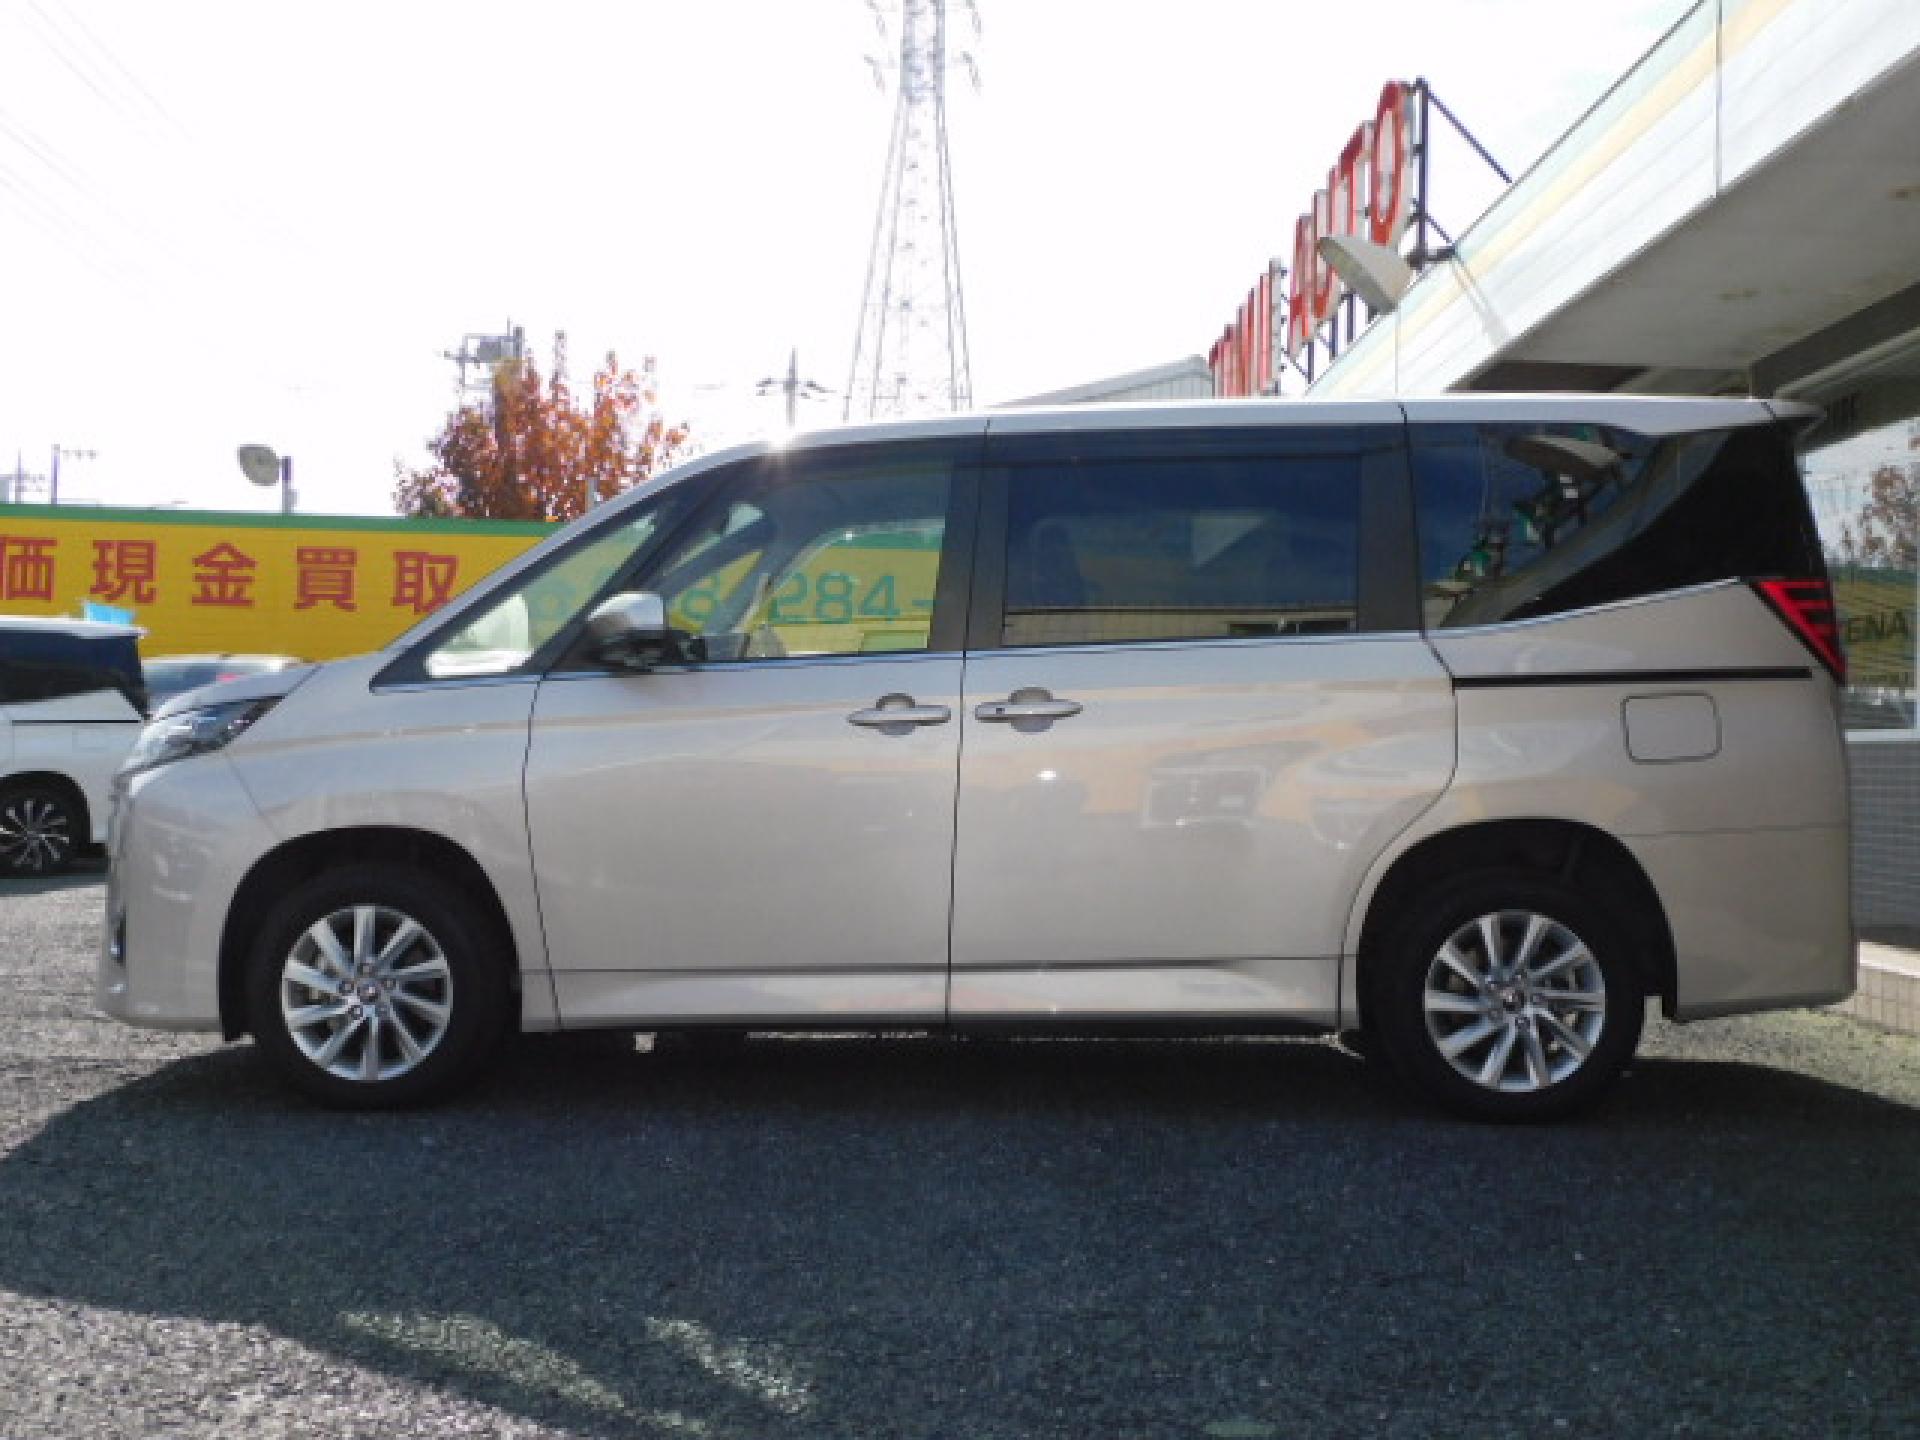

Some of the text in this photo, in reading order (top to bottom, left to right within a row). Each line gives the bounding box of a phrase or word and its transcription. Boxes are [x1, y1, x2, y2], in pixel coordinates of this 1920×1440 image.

[0, 535, 458, 615] 価現金買取
